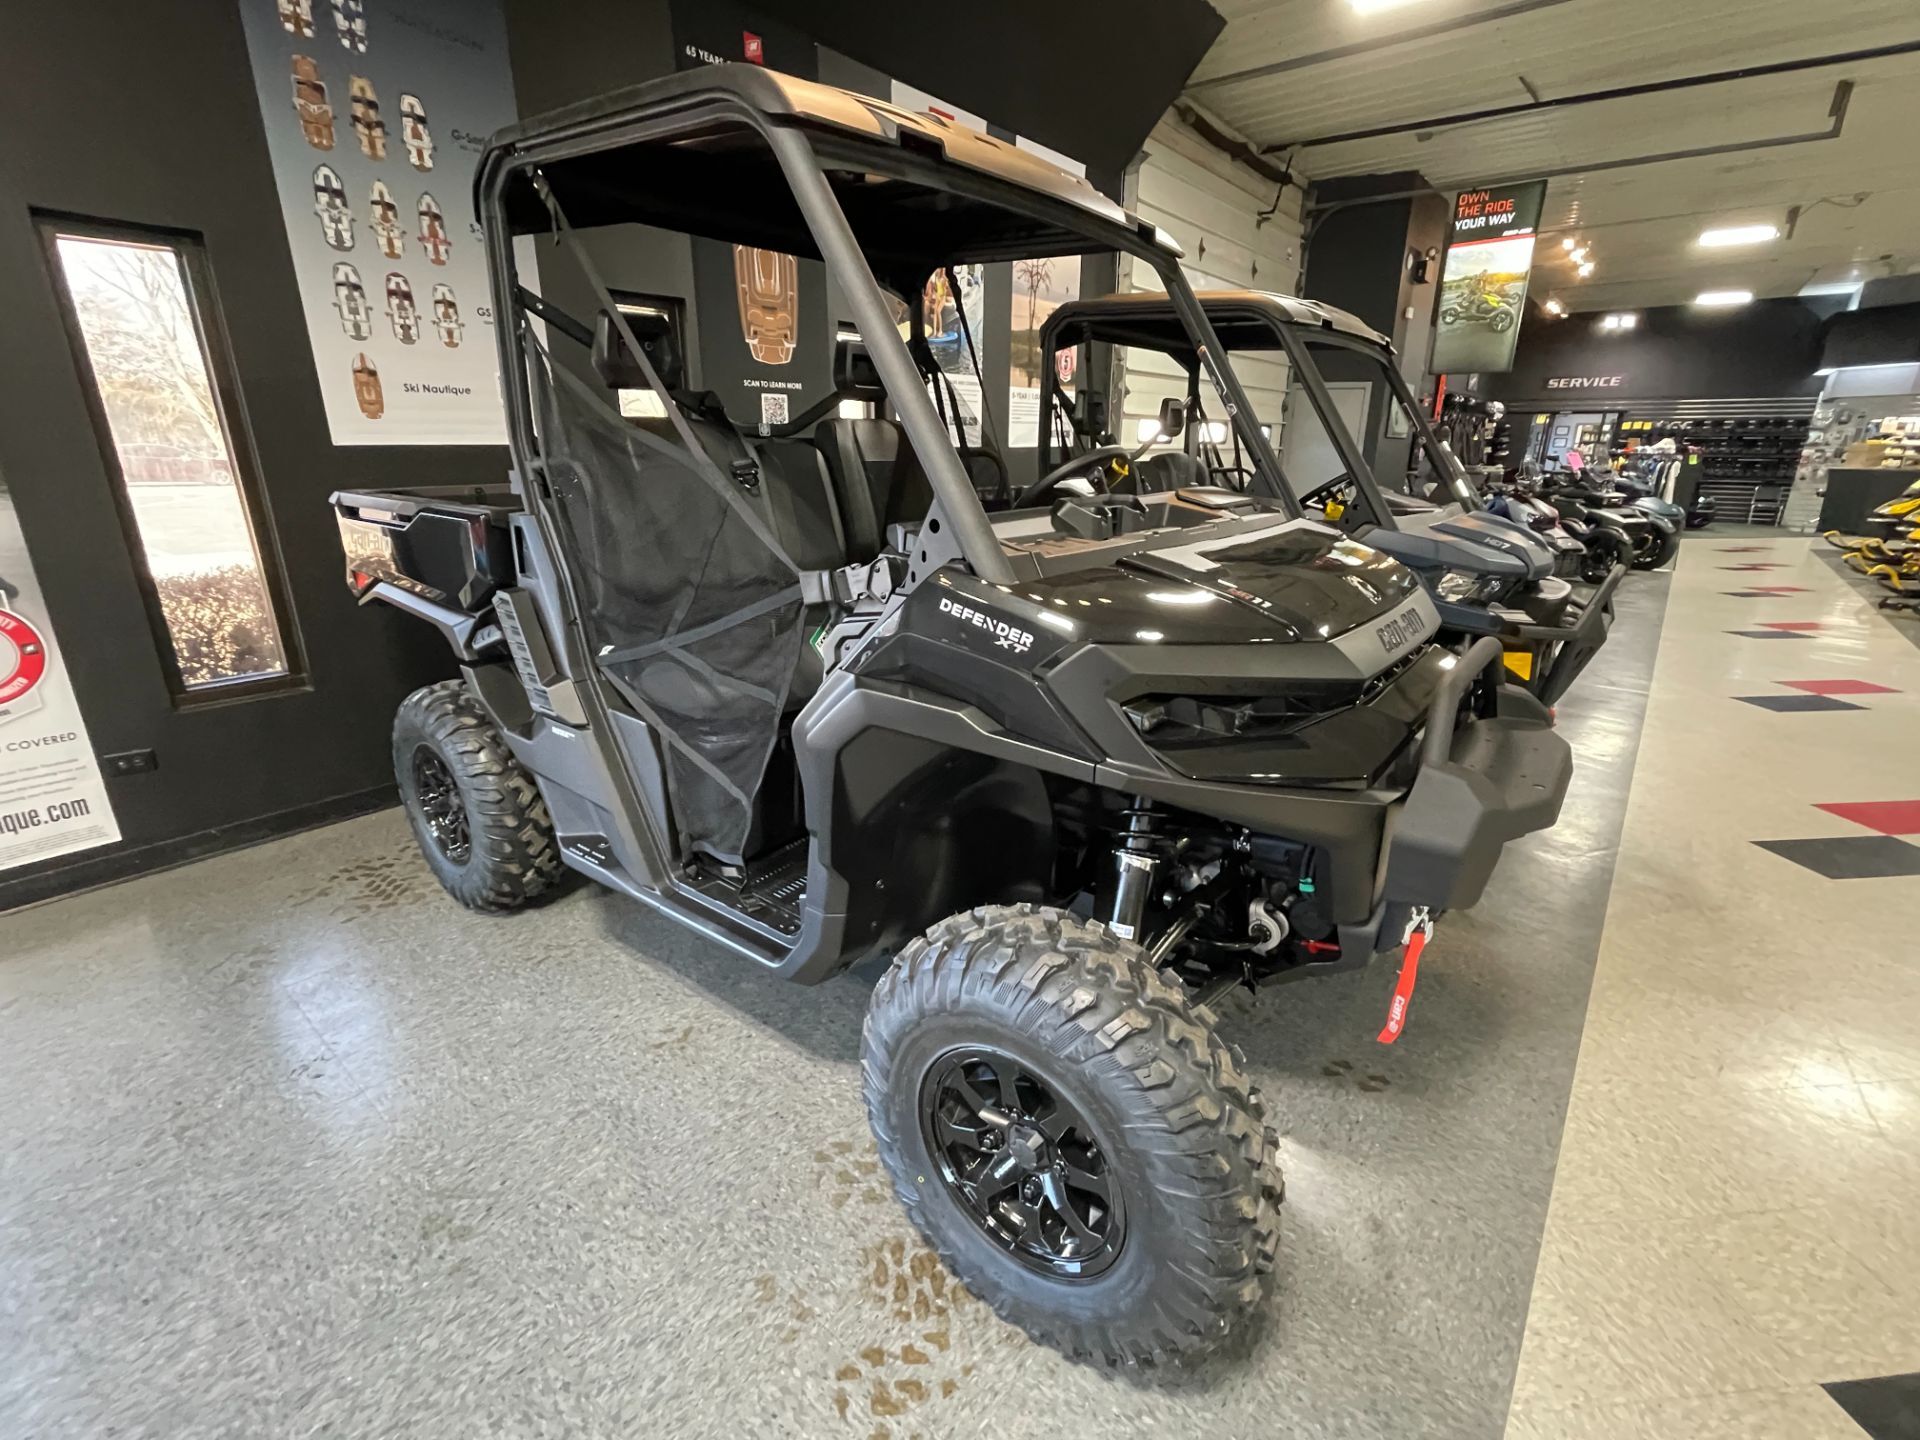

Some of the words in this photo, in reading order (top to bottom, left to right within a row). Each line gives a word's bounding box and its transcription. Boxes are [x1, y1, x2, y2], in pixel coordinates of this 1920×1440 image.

[685, 45, 697, 58] 65
[1459, 190, 1490, 206] OWN
[1458, 205, 1481, 218] THE
[1485, 199, 1515, 214] RIDE
[1455, 216, 1486, 231] YOUR
[1489, 212, 1516, 226] WAY
[403, 383, 420, 393] Ski
[422, 384, 472, 396] Nautique
[743, 379, 760, 387] SCAN
[760, 380, 769, 388] TO
[1547, 376, 1622, 389] SERVICE
[939, 597, 1034, 648] DEFENDER
[994, 636, 1029, 653] XT
[6, 732, 77, 752] COVERED
